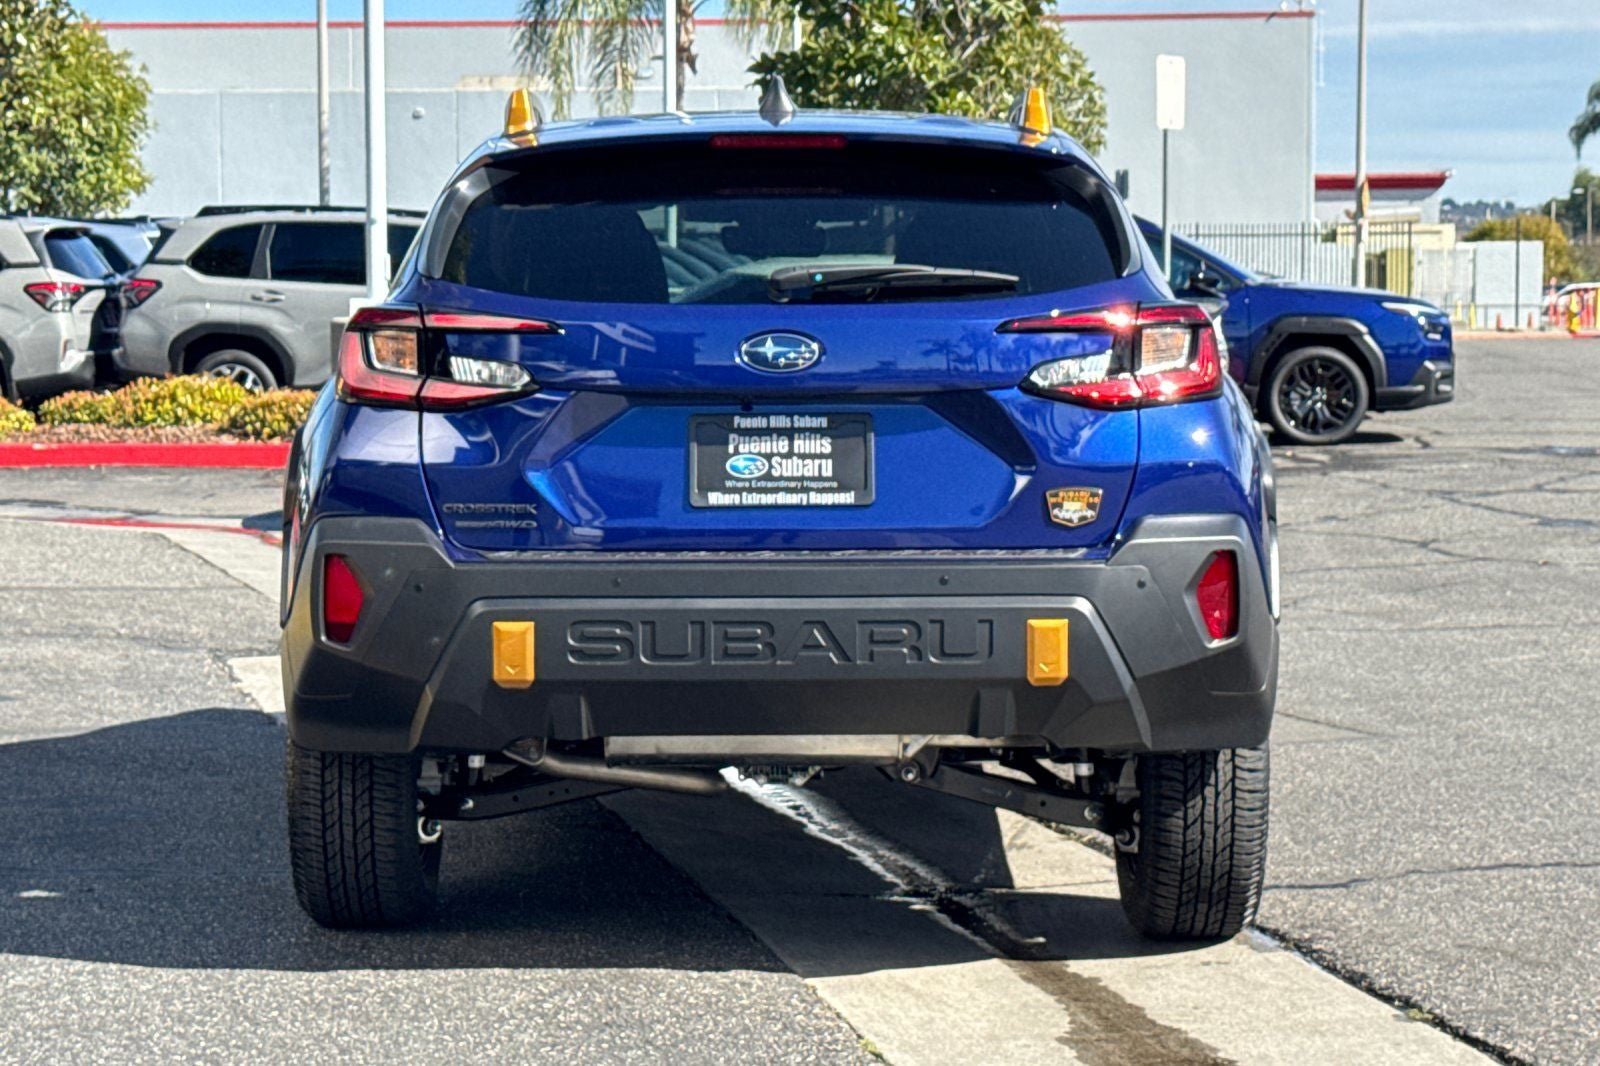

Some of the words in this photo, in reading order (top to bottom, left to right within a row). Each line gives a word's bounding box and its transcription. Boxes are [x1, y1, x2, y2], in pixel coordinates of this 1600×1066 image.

[733, 415, 768, 428] Puente
[769, 415, 792, 428] Hills
[793, 415, 828, 428] Subaru
[728, 433, 789, 454] Puente
[793, 432, 832, 454] Hills
[771, 456, 833, 477] Subaru
[725, 480, 750, 488] Where
[751, 480, 801, 490] Extraordinary
[803, 480, 838, 490] Happens
[707, 492, 741, 505] Where
[742, 491, 808, 506] Extraordinary
[809, 491, 855, 505] Happens!
[442, 503, 537, 514] CROSSTREK
[567, 619, 994, 666] SUBARU
